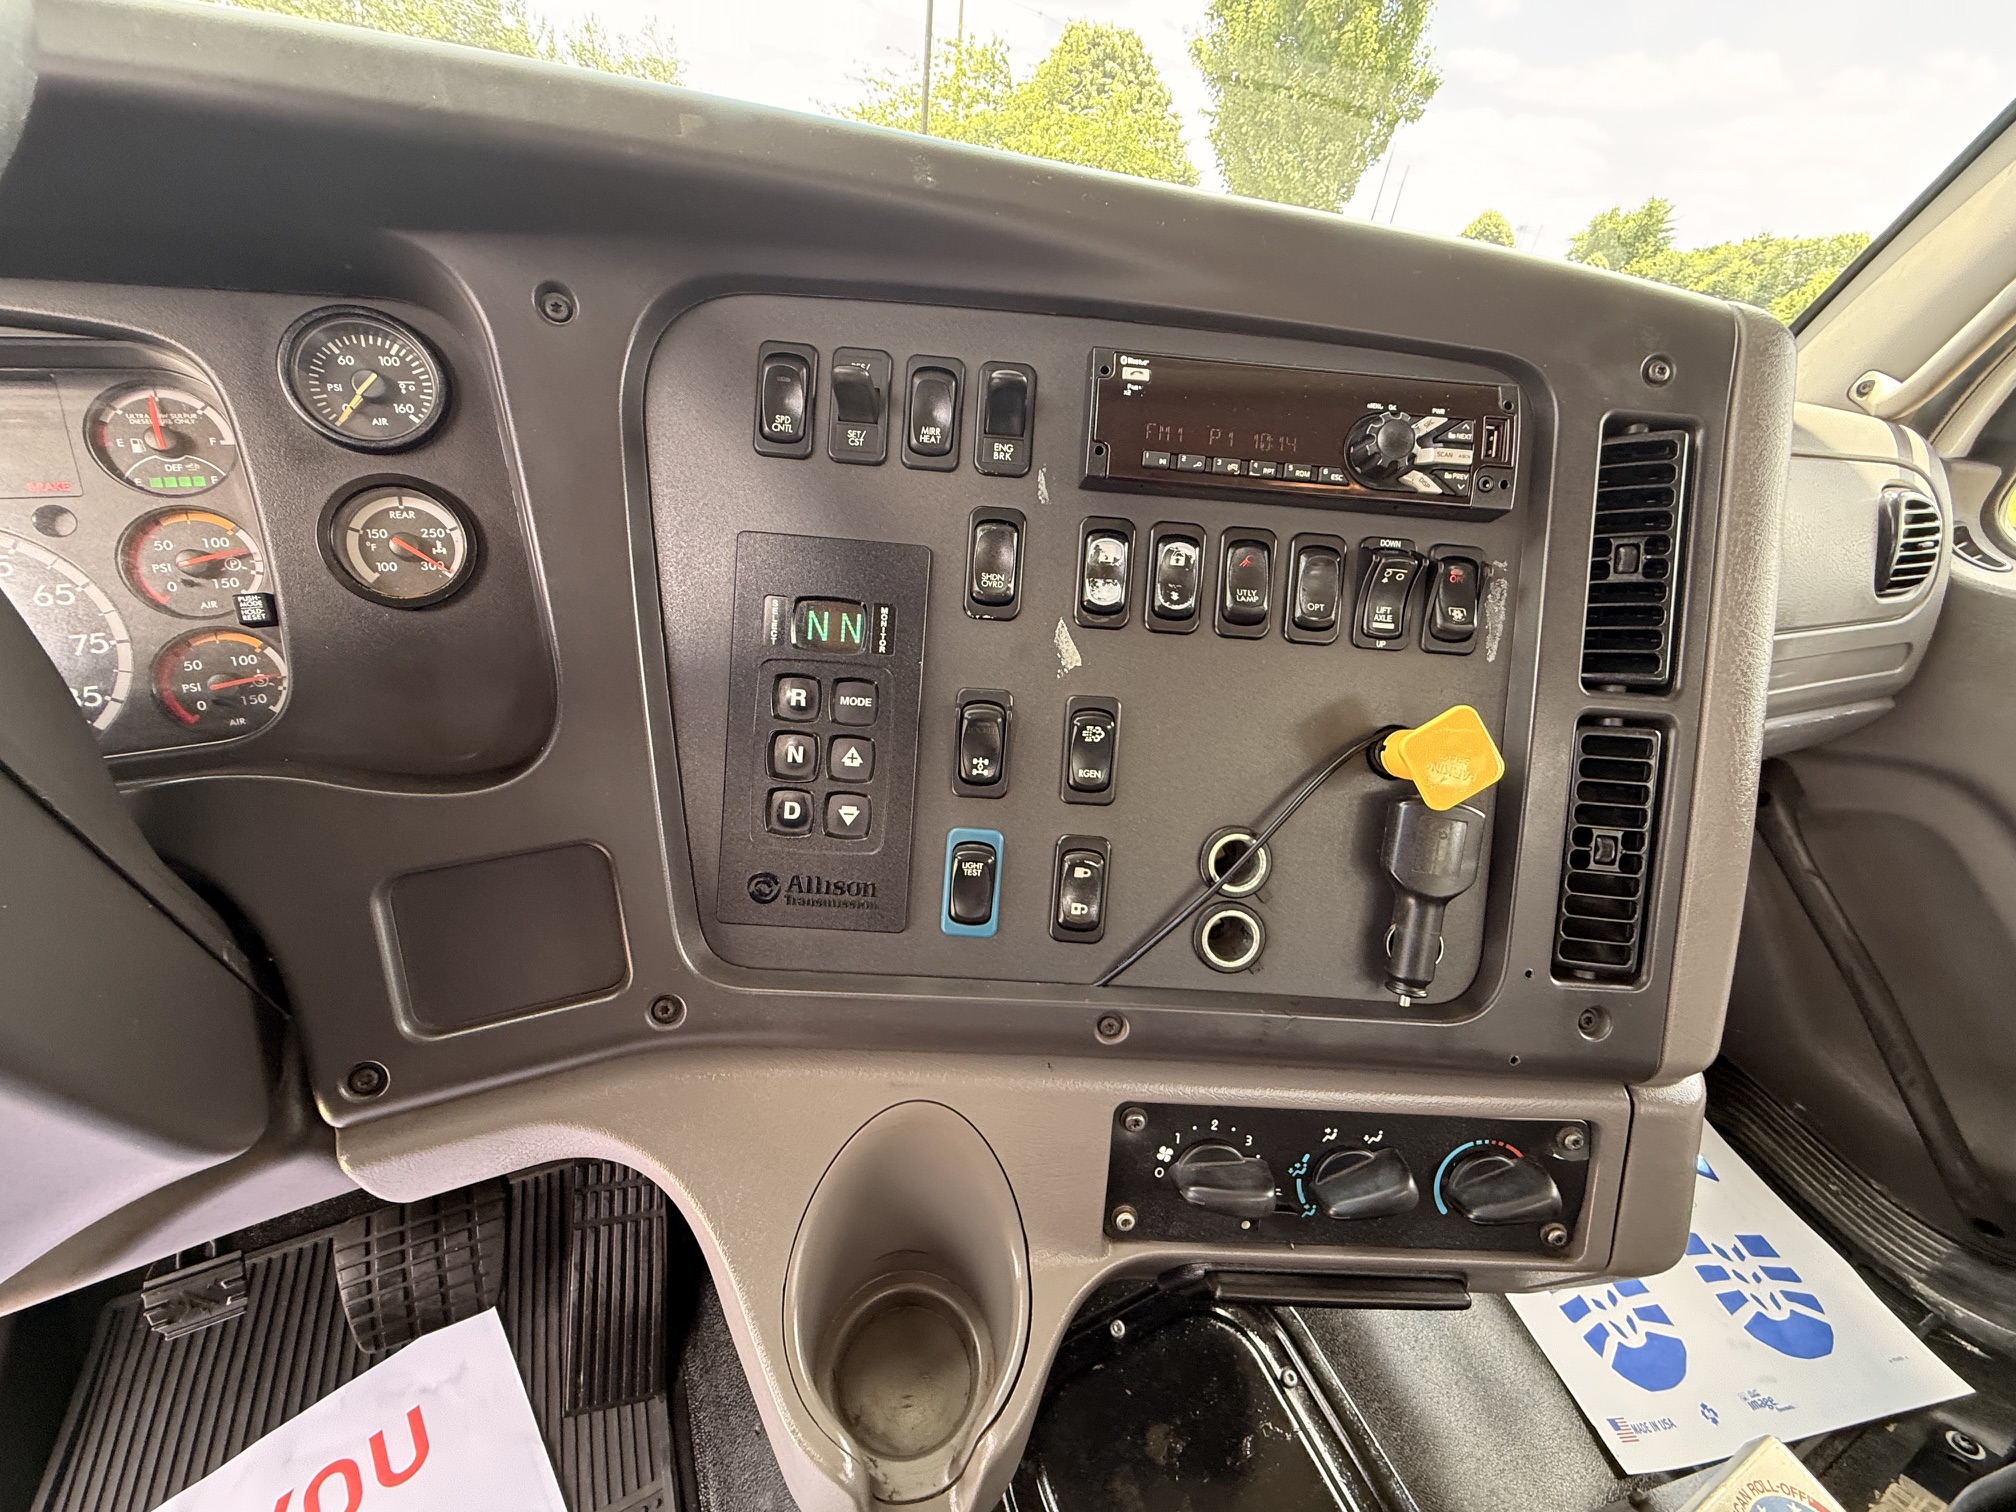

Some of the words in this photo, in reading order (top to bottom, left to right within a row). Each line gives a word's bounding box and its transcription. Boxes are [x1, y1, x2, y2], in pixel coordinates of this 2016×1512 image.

[337, 355, 354, 366] 60
[378, 356, 401, 367] 100
[326, 383, 343, 392] PSI
[393, 403, 414, 413] 160
[372, 417, 389, 426] AIR
[775, 415, 792, 424] SPD
[772, 423, 793, 433] CNTL
[921, 426, 941, 435] MIRR
[847, 429, 867, 439] SET/
[919, 434, 941, 444] HEAT
[116, 438, 125, 447] E
[209, 437, 217, 446] F
[848, 437, 864, 446] CST
[993, 443, 1014, 452] ENG
[993, 451, 1012, 461] BRK
[164, 463, 183, 472] DEF
[1262, 467, 1276, 476] RPT
[1330, 474, 1344, 482] ESC
[26, 481, 71, 492] BRAKE
[389, 510, 416, 519] REAR
[366, 529, 388, 539] 150
[420, 528, 445, 538] 250
[154, 540, 174, 550] 50
[202, 537, 230, 548] 100
[1380, 539, 1401, 548] DOWN
[152, 563, 172, 573] PSI
[375, 561, 398, 572] 100
[420, 561, 445, 571] 300
[981, 572, 1004, 582] SHDN
[167, 581, 178, 592] 0
[212, 577, 240, 589] 150
[981, 580, 1004, 589] OVRD
[33, 584, 76, 607] 65
[1237, 588, 1257, 597] UTLY
[1236, 595, 1259, 603] LAMP
[200, 600, 218, 609] AIR
[1307, 603, 1325, 612] OPT
[1375, 606, 1392, 615] LIFT
[242, 613, 266, 621] RESET
[1373, 614, 1393, 622] AXLE
[770, 599, 779, 646] SELECT
[807, 610, 829, 641] N
[841, 612, 862, 644] N
[878, 606, 889, 654] MONITOR
[68, 633, 110, 656] 75
[1376, 640, 1386, 648] UP
[230, 654, 258, 666] 100
[184, 660, 203, 671] 50
[182, 682, 201, 693] PSI
[241, 694, 267, 705] 150
[790, 688, 807, 707] R
[839, 696, 872, 707] MODE
[196, 701, 207, 711] 0
[229, 718, 247, 726] AIR
[787, 746, 804, 764] N
[1078, 769, 1102, 779] RGEN
[783, 801, 801, 819] D
[962, 861, 984, 870] LIGHT
[963, 868, 982, 877] TEST
[785, 874, 878, 898] Allison
[1210, 1119, 1219, 1131] 2
[1175, 1132, 1181, 1144] 1
[1244, 1134, 1253, 1146] 3
[1630, 1421, 1652, 1434] MADE
[1652, 1420, 1661, 1432] IN
[1661, 1418, 1677, 1430] USA
[274, 1405, 430, 1512] OU
[1746, 1480, 1808, 1502] ROLL-OFF
